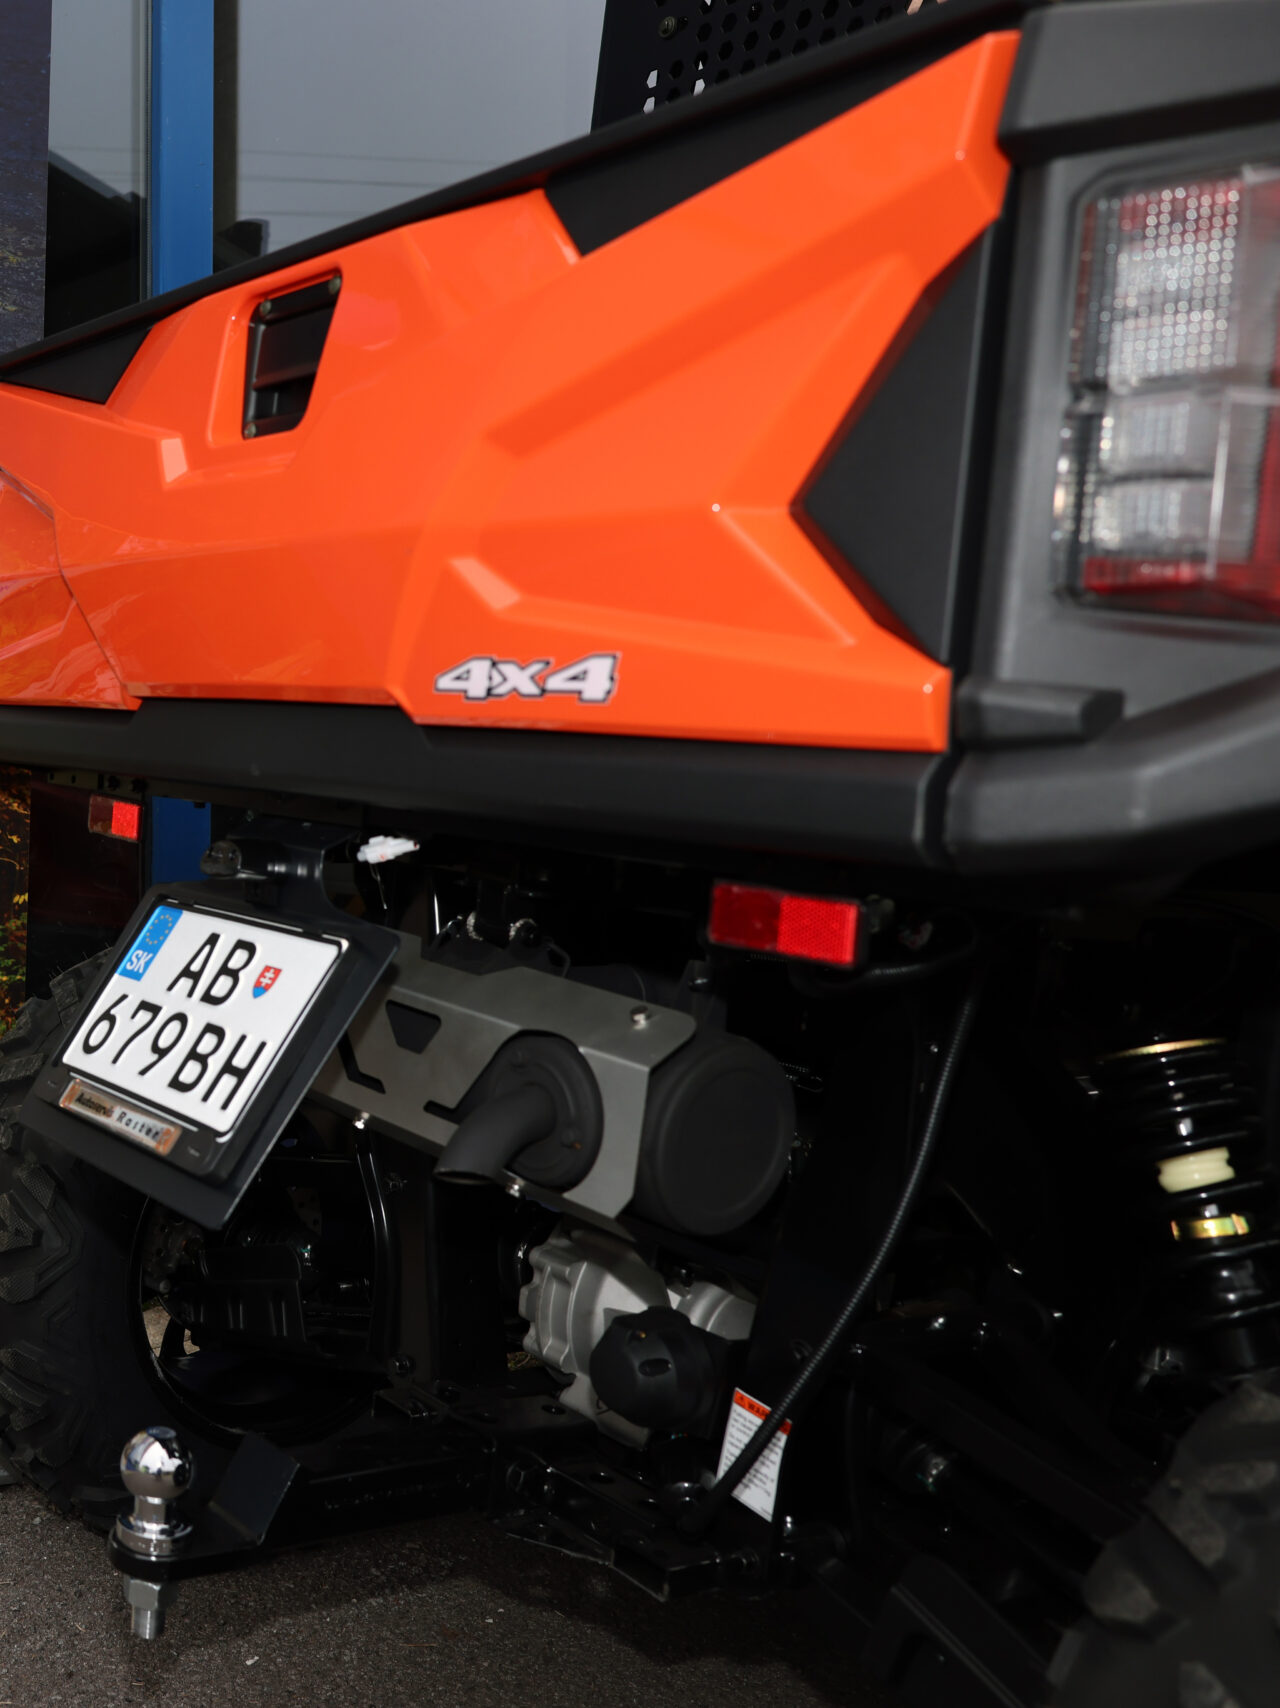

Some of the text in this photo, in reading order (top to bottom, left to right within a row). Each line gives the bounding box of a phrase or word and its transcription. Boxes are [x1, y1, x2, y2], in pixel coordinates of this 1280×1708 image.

[433, 653, 619, 703] 4x4
[126, 949, 153, 974] SK
[166, 932, 257, 1006] AB
[82, 994, 267, 1111] 679BH
